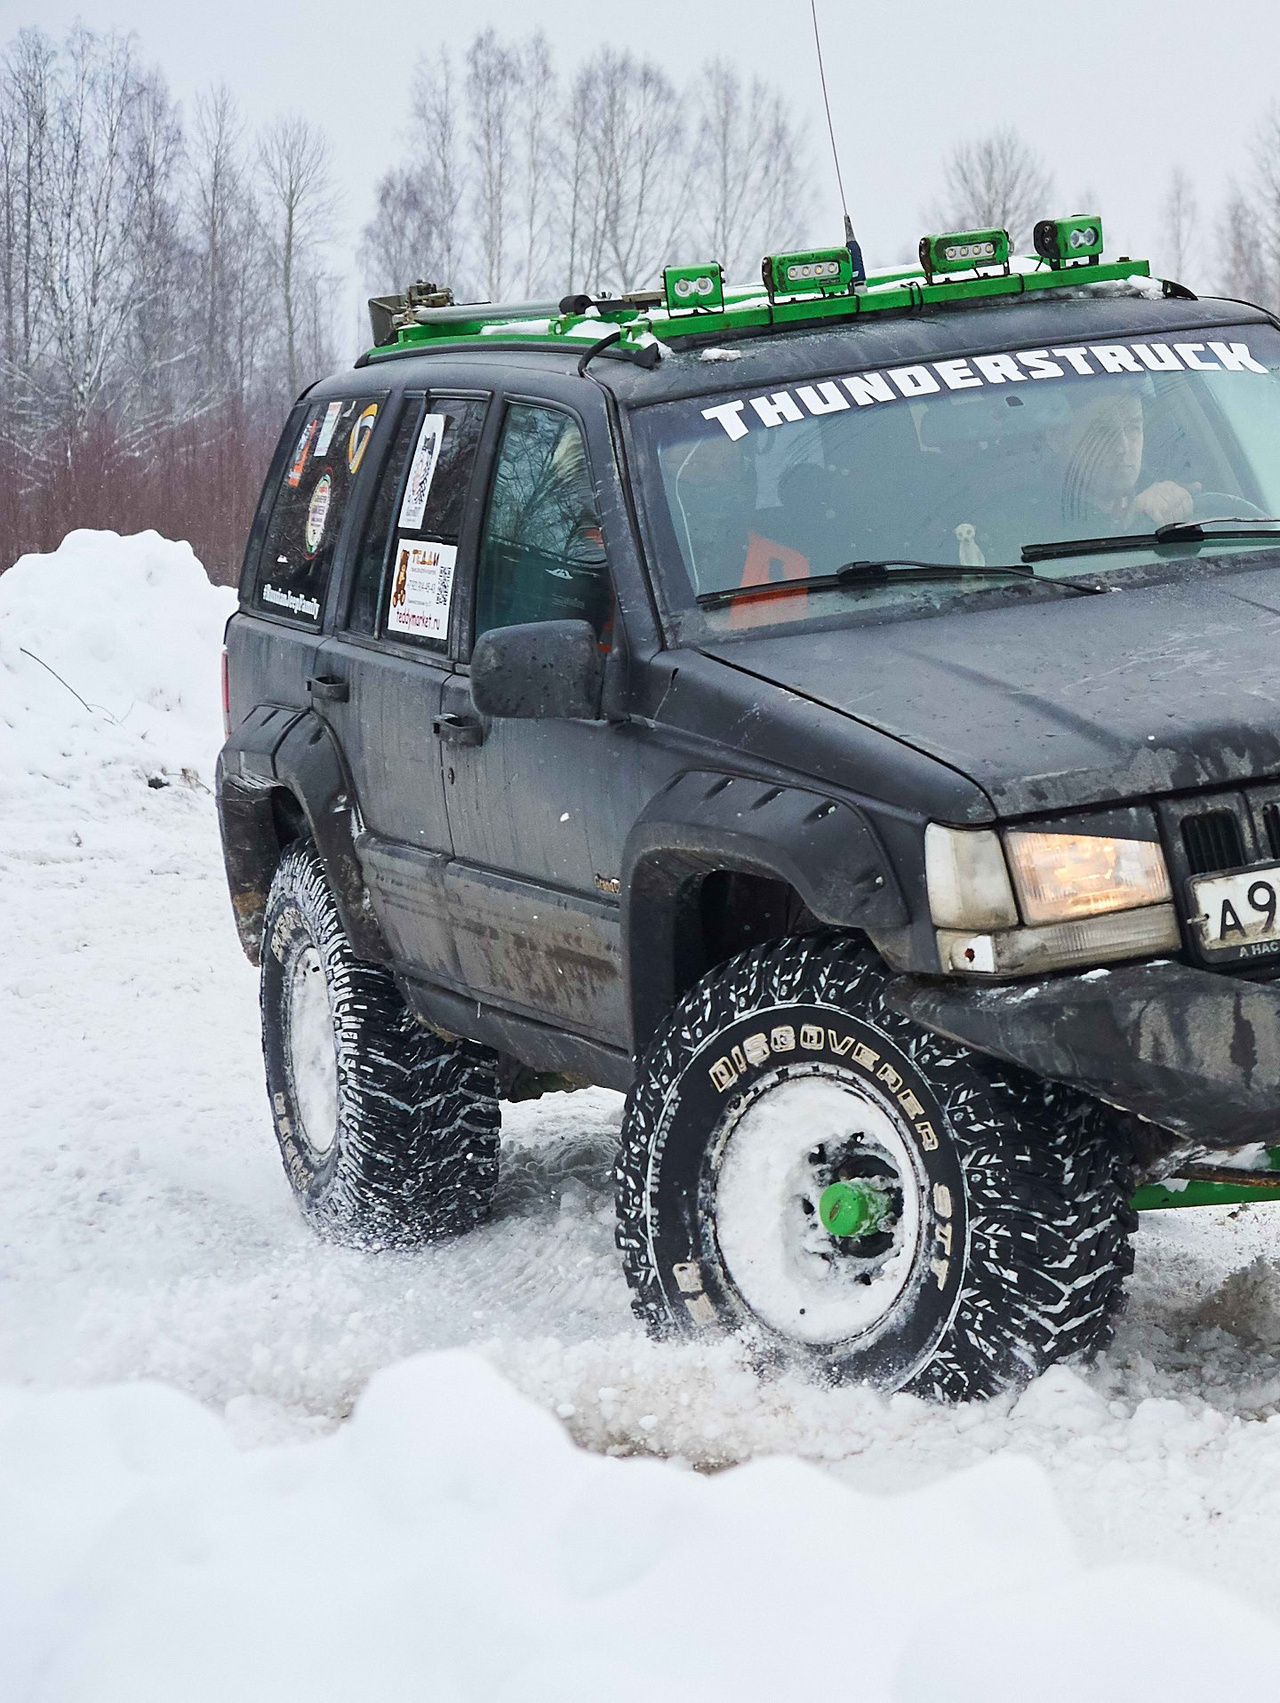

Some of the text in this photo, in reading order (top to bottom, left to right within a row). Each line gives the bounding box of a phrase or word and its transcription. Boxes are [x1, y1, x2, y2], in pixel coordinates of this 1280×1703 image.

[700, 341, 1269, 442] THUNDERSTRUCK
[396, 608, 440, 630] teddymarket.ru
[1239, 946, 1249, 958] А
[1251, 941, 1279, 955] НАС
[708, 1025, 940, 1152] DISCOVERER
